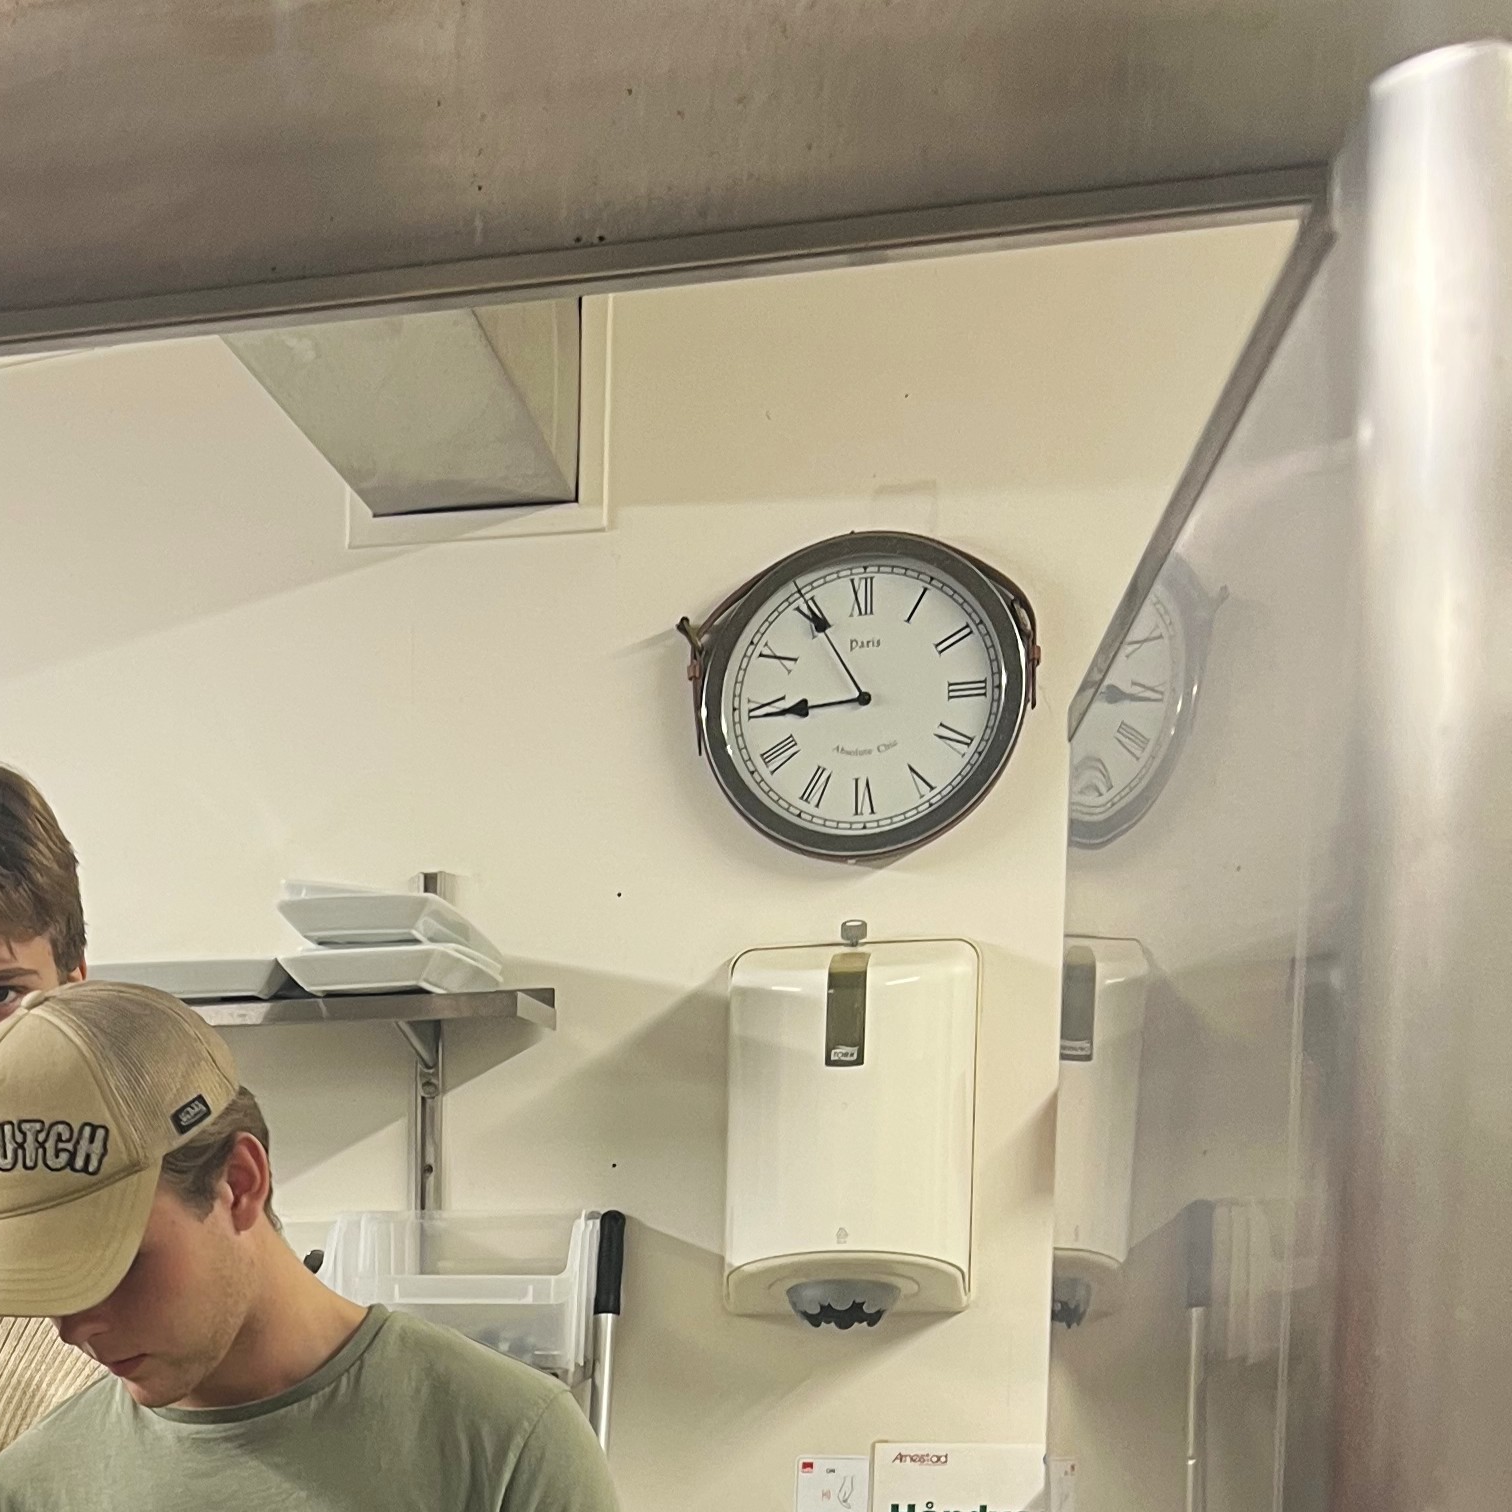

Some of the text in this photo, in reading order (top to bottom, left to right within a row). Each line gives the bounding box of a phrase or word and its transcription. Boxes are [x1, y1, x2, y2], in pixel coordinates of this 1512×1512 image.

[849, 576, 875, 617] XII
[849, 637, 881, 652] Paris
[933, 622, 975, 656] II
[758, 640, 799, 675] X
[947, 677, 987, 701] III
[906, 763, 937, 799] V
